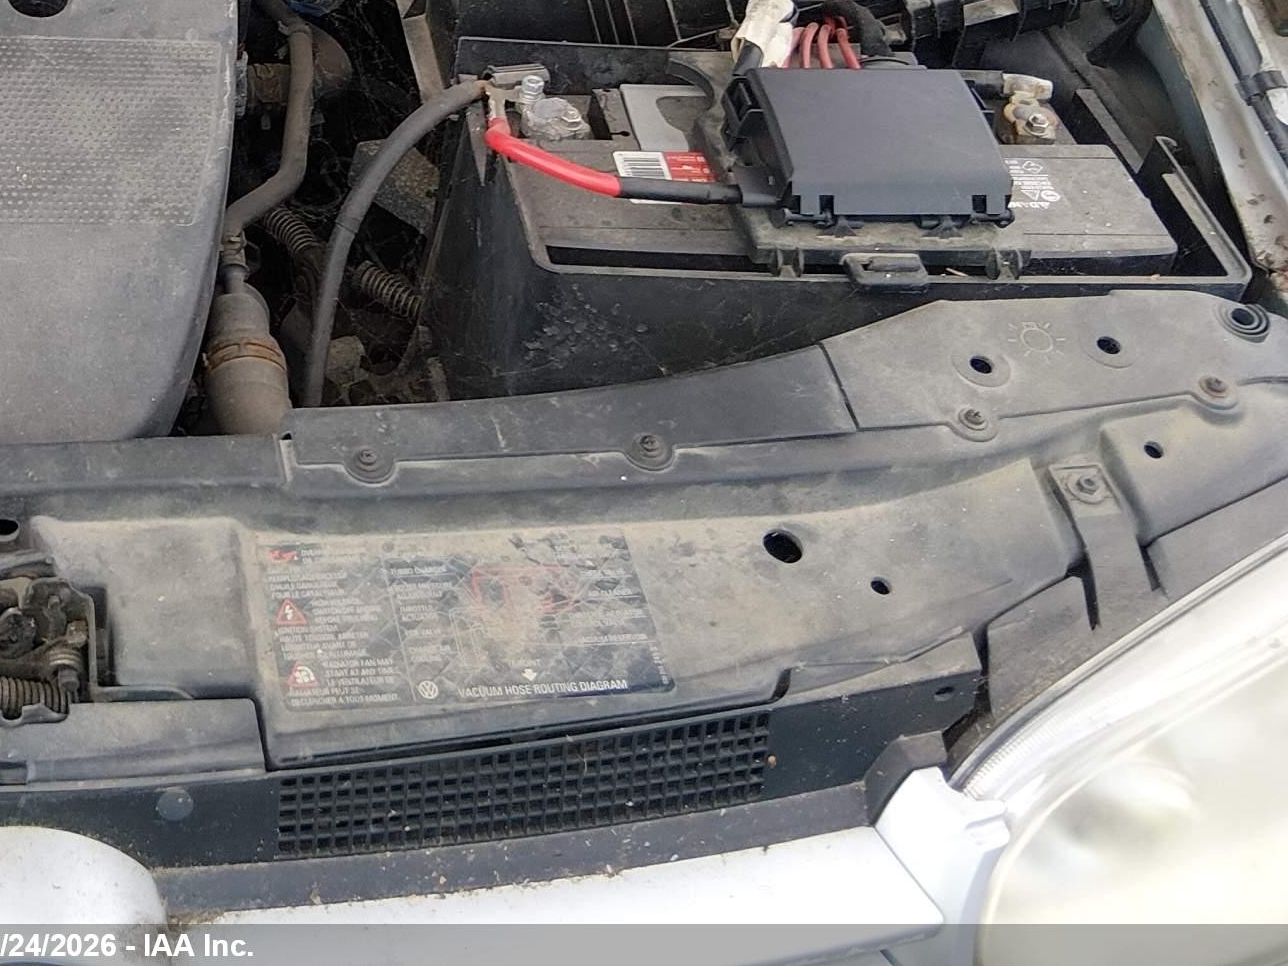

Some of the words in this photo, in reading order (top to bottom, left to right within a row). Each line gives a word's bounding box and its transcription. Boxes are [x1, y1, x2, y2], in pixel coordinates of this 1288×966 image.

[457, 685, 504, 699] VACUUM
[504, 684, 534, 696] HOSE
[534, 681, 578, 695] ROUTING
[578, 679, 628, 692] DIAGRAM
